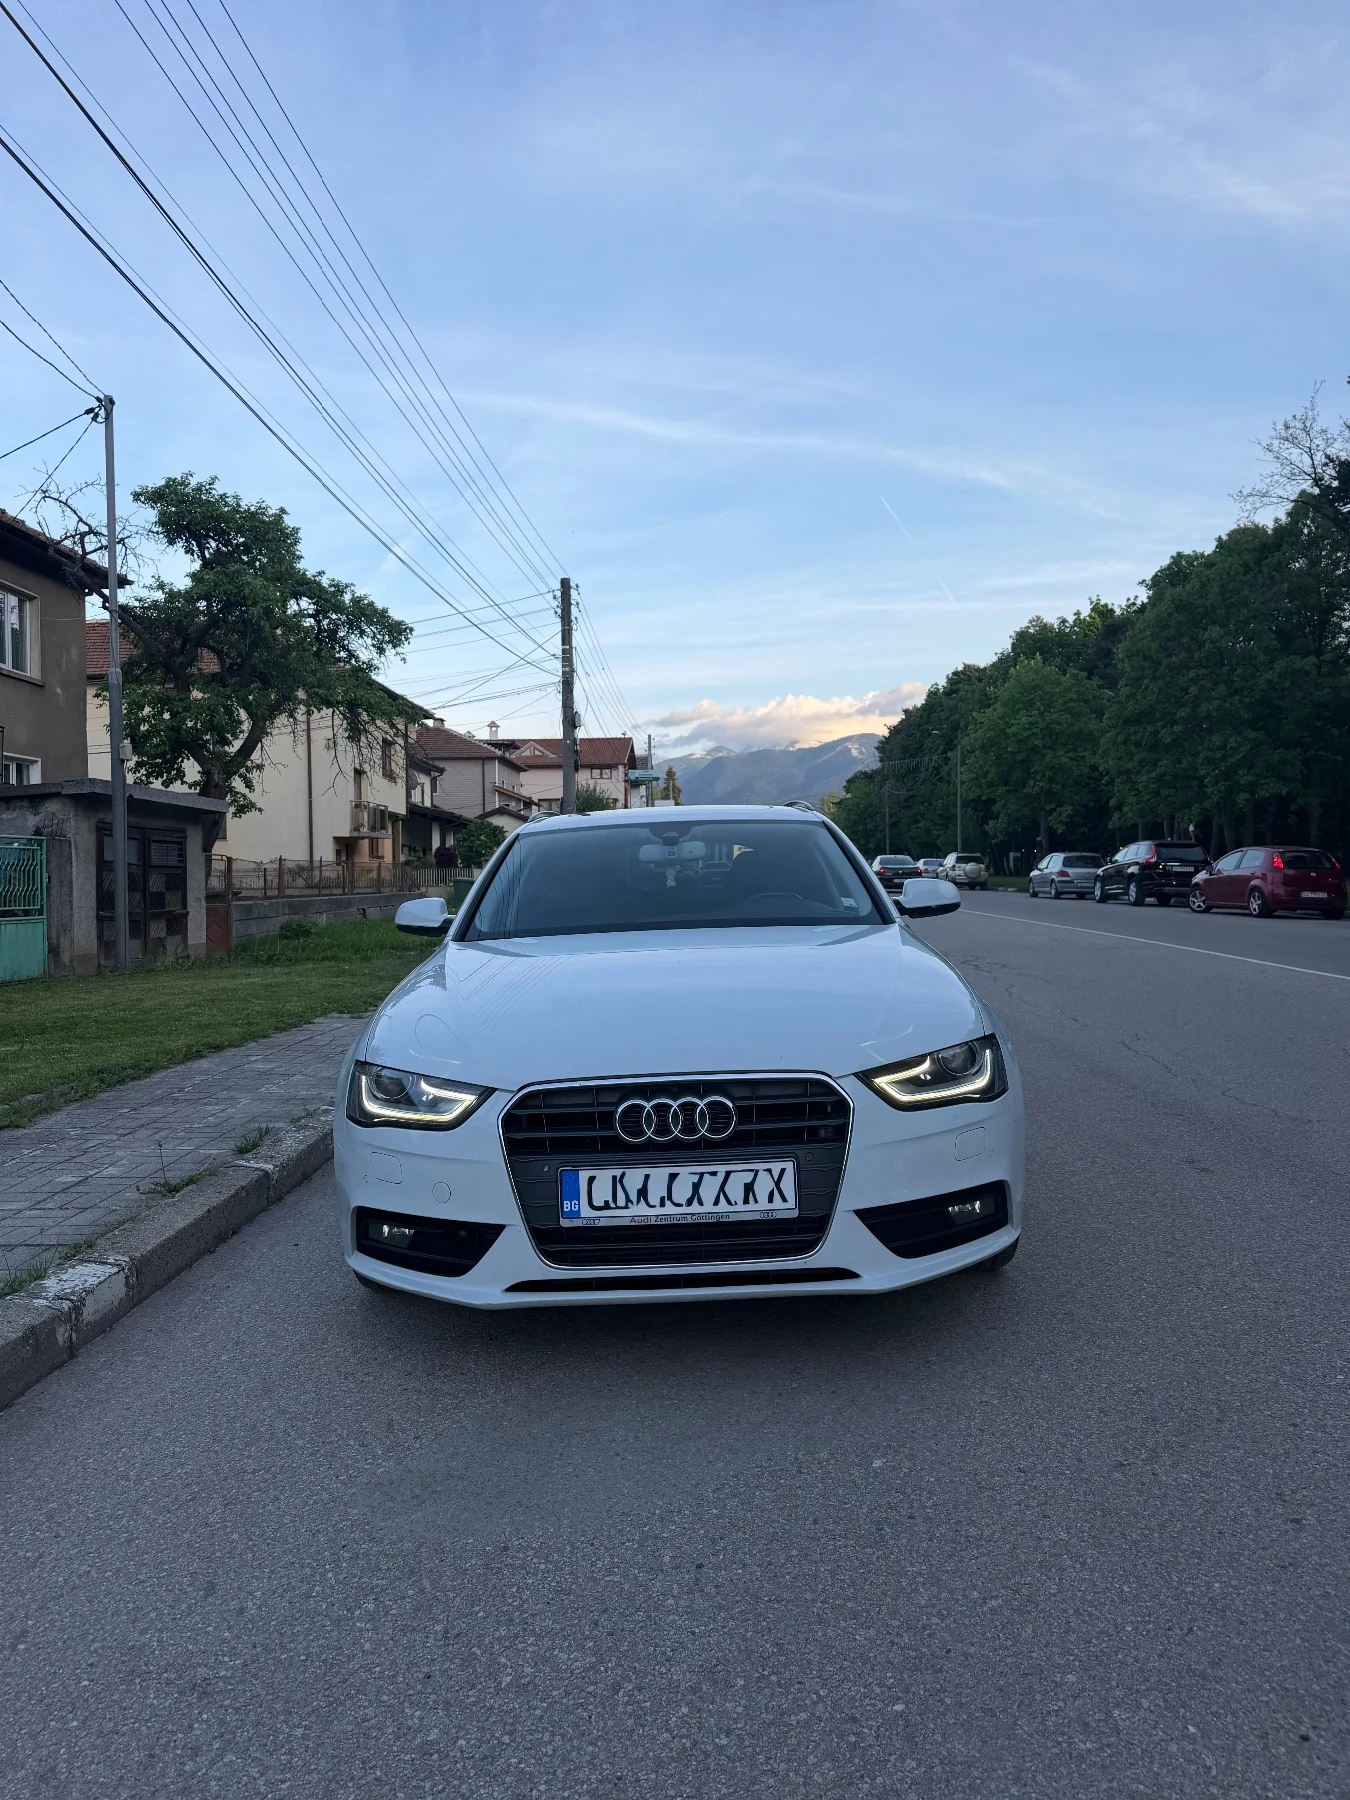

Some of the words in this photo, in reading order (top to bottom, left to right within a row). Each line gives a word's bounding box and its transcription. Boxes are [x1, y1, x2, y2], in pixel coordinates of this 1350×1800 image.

[564, 1201, 578, 1211] BG
[629, 1216, 652, 1224] Audi
[654, 1215, 688, 1223] Zentrum
[690, 1213, 730, 1221] Göttingen
